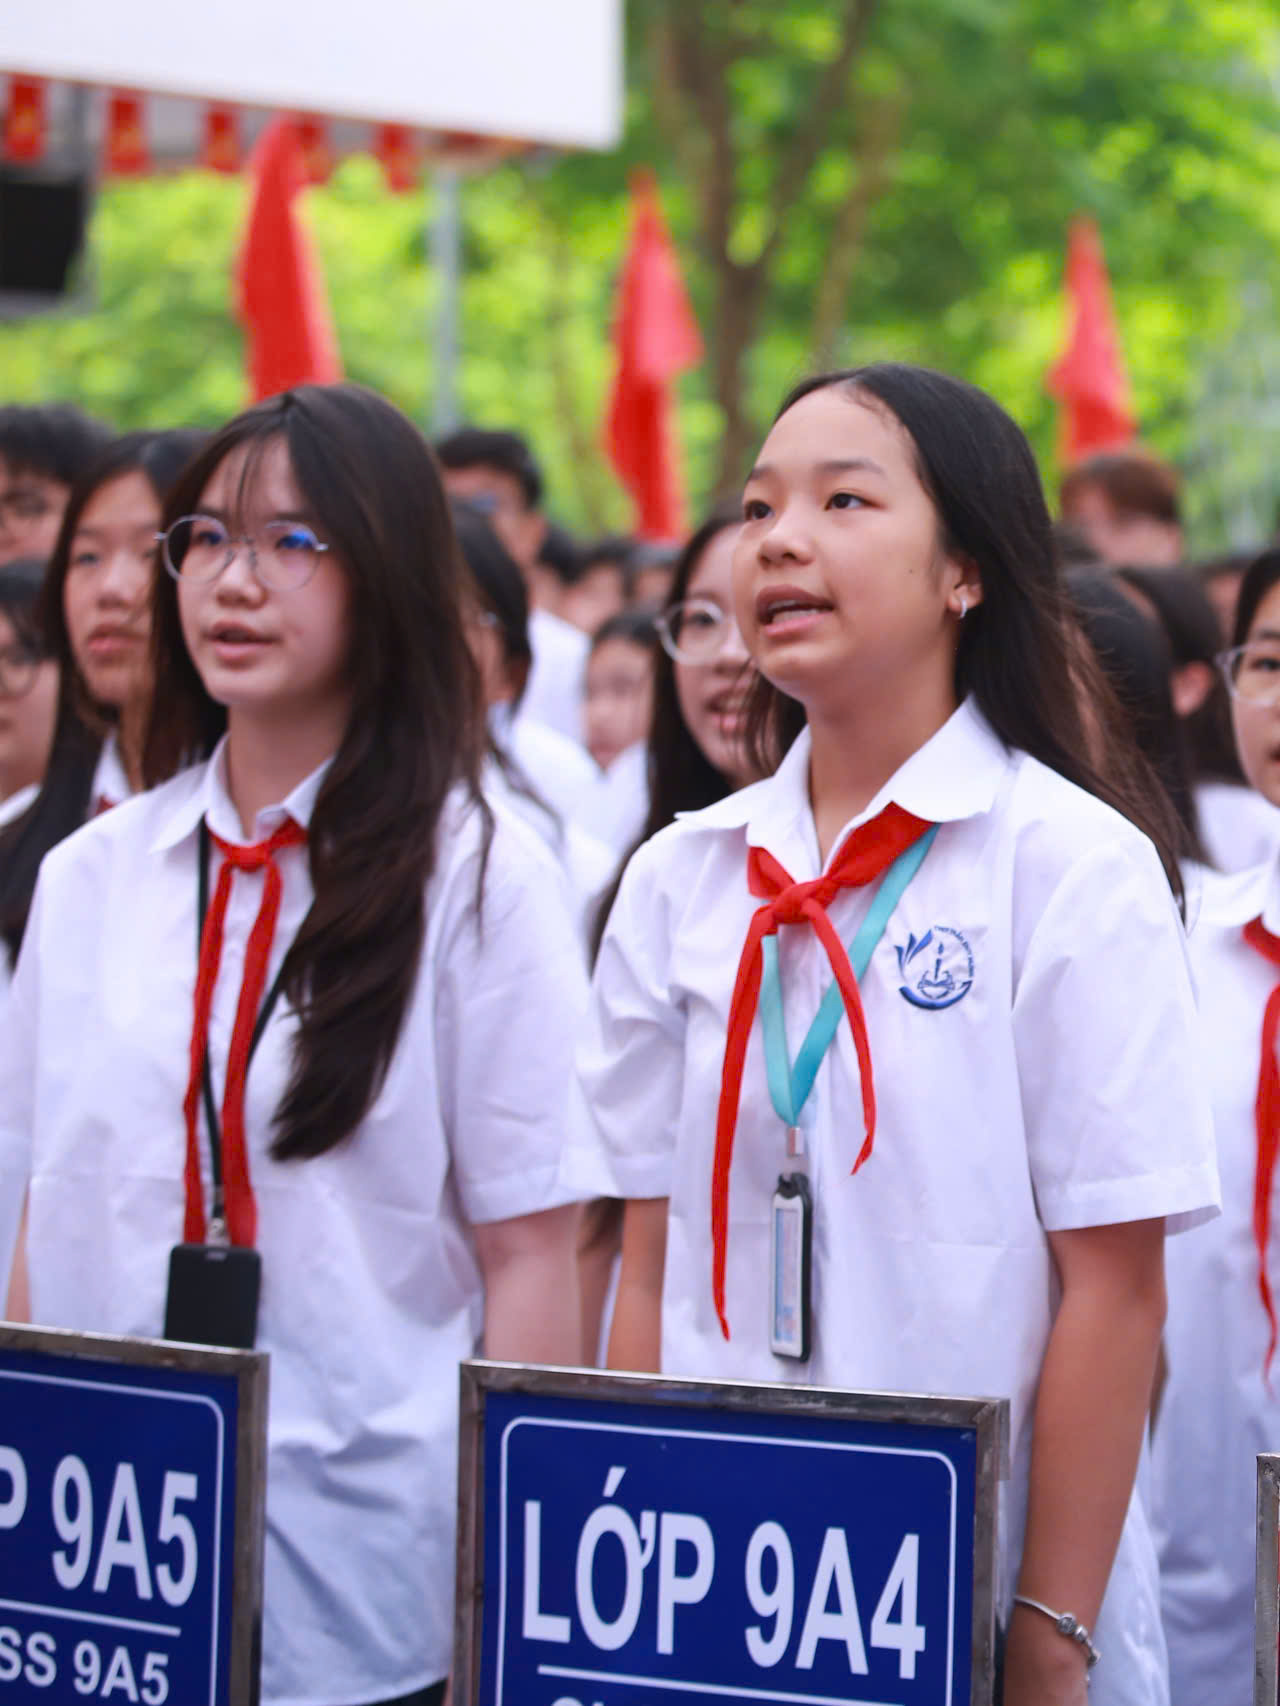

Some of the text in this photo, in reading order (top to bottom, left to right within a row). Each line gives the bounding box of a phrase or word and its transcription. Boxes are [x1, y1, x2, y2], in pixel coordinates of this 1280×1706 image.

[52, 1454, 199, 1608] 9A5
[522, 1465, 926, 1680] LỚP 9A4
[72, 1639, 169, 1706] 9A5
